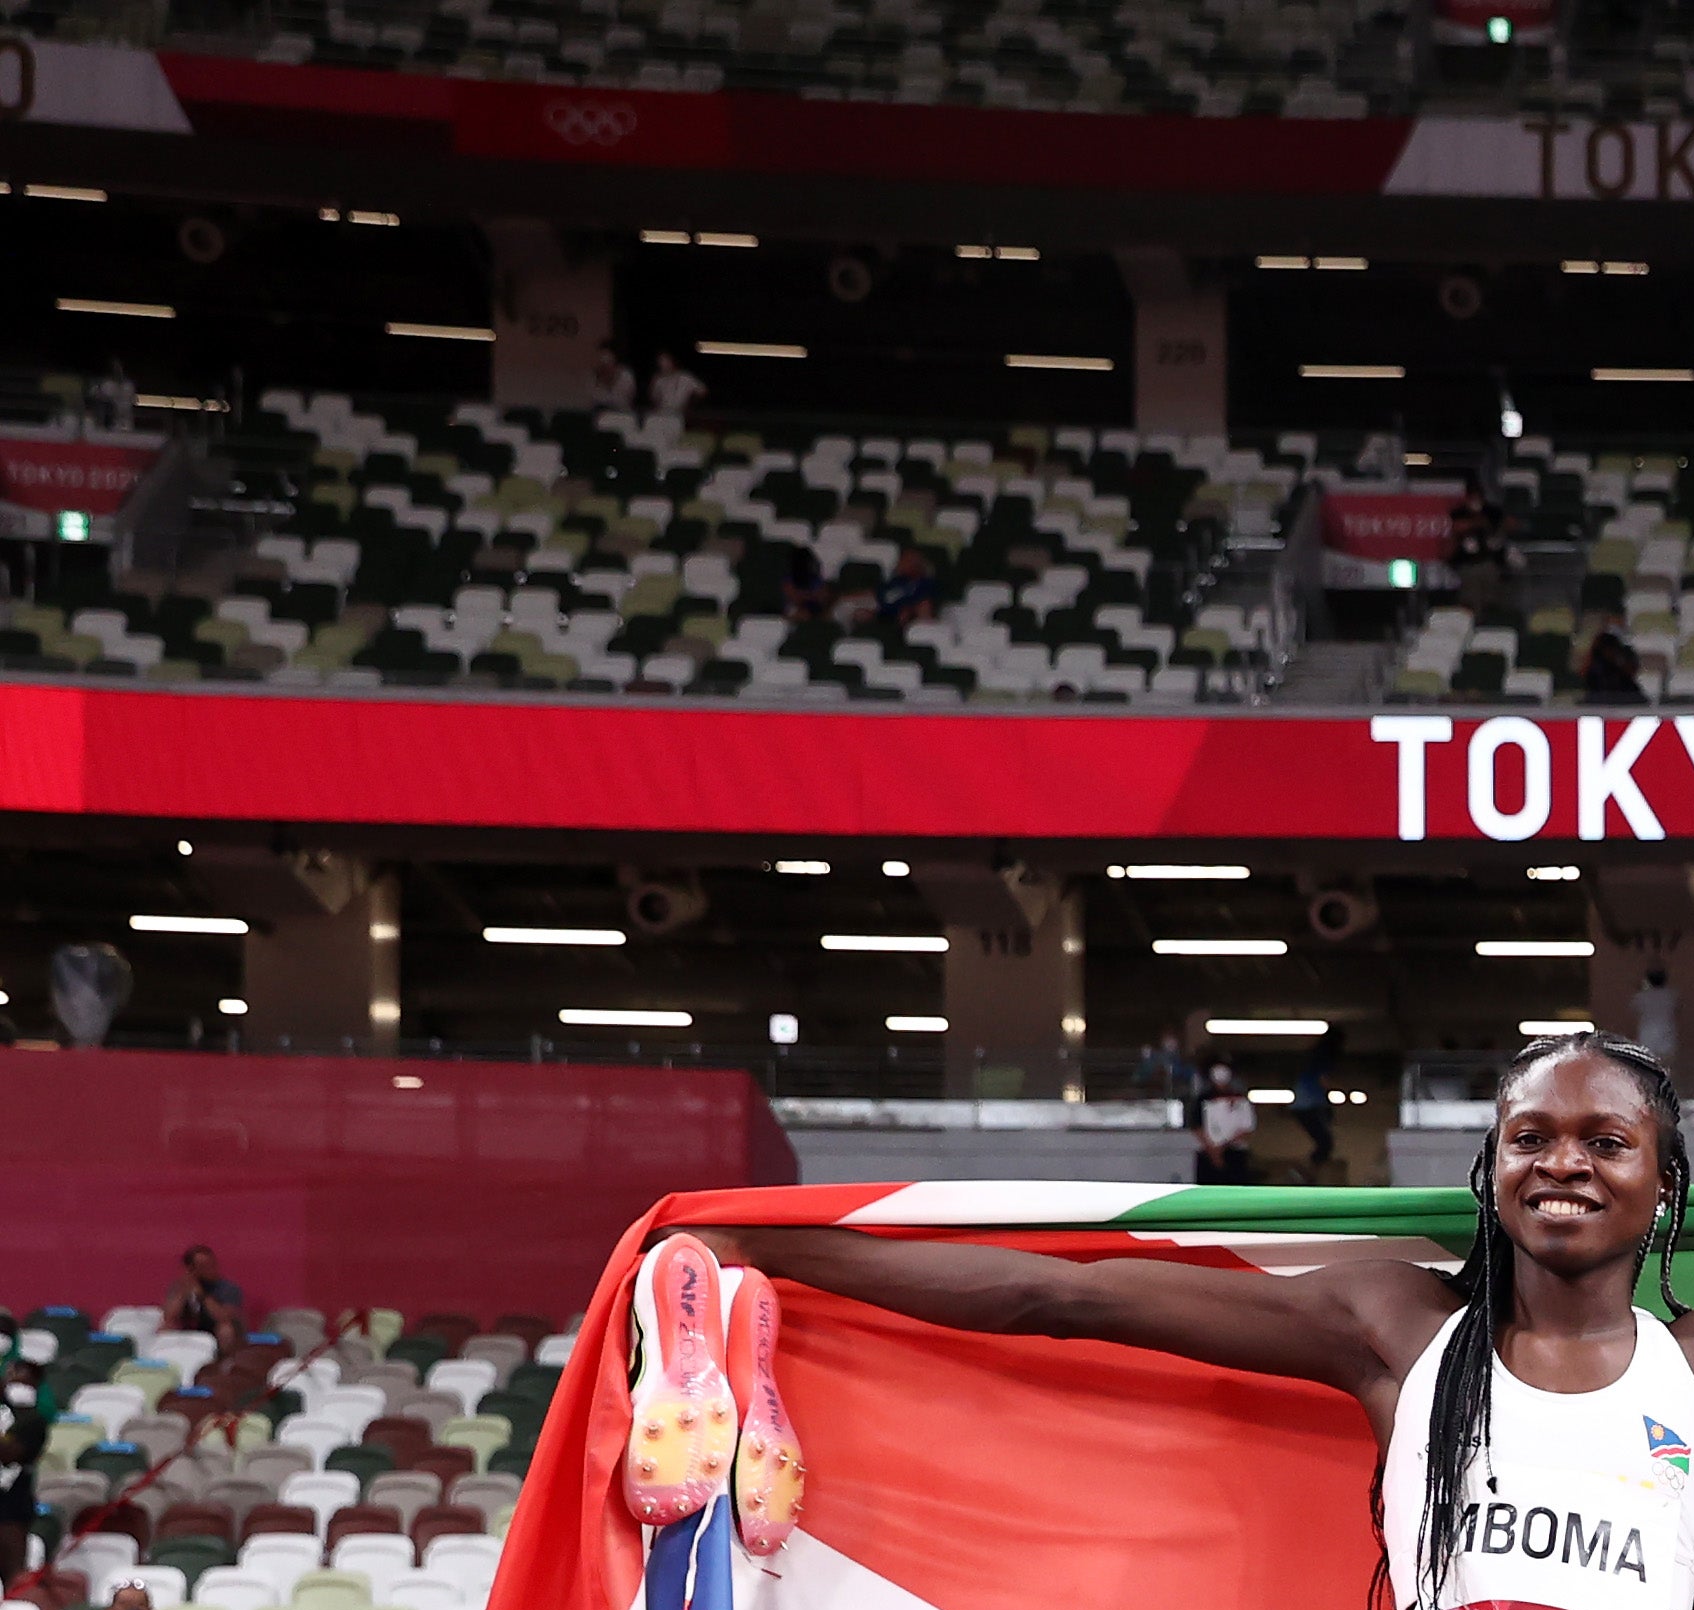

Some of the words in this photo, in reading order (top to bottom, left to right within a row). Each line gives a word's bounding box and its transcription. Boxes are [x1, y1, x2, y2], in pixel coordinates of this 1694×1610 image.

[90, 465, 139, 491] 202
[1344, 514, 1412, 539] TOKYO
[1416, 514, 1452, 539] 202
